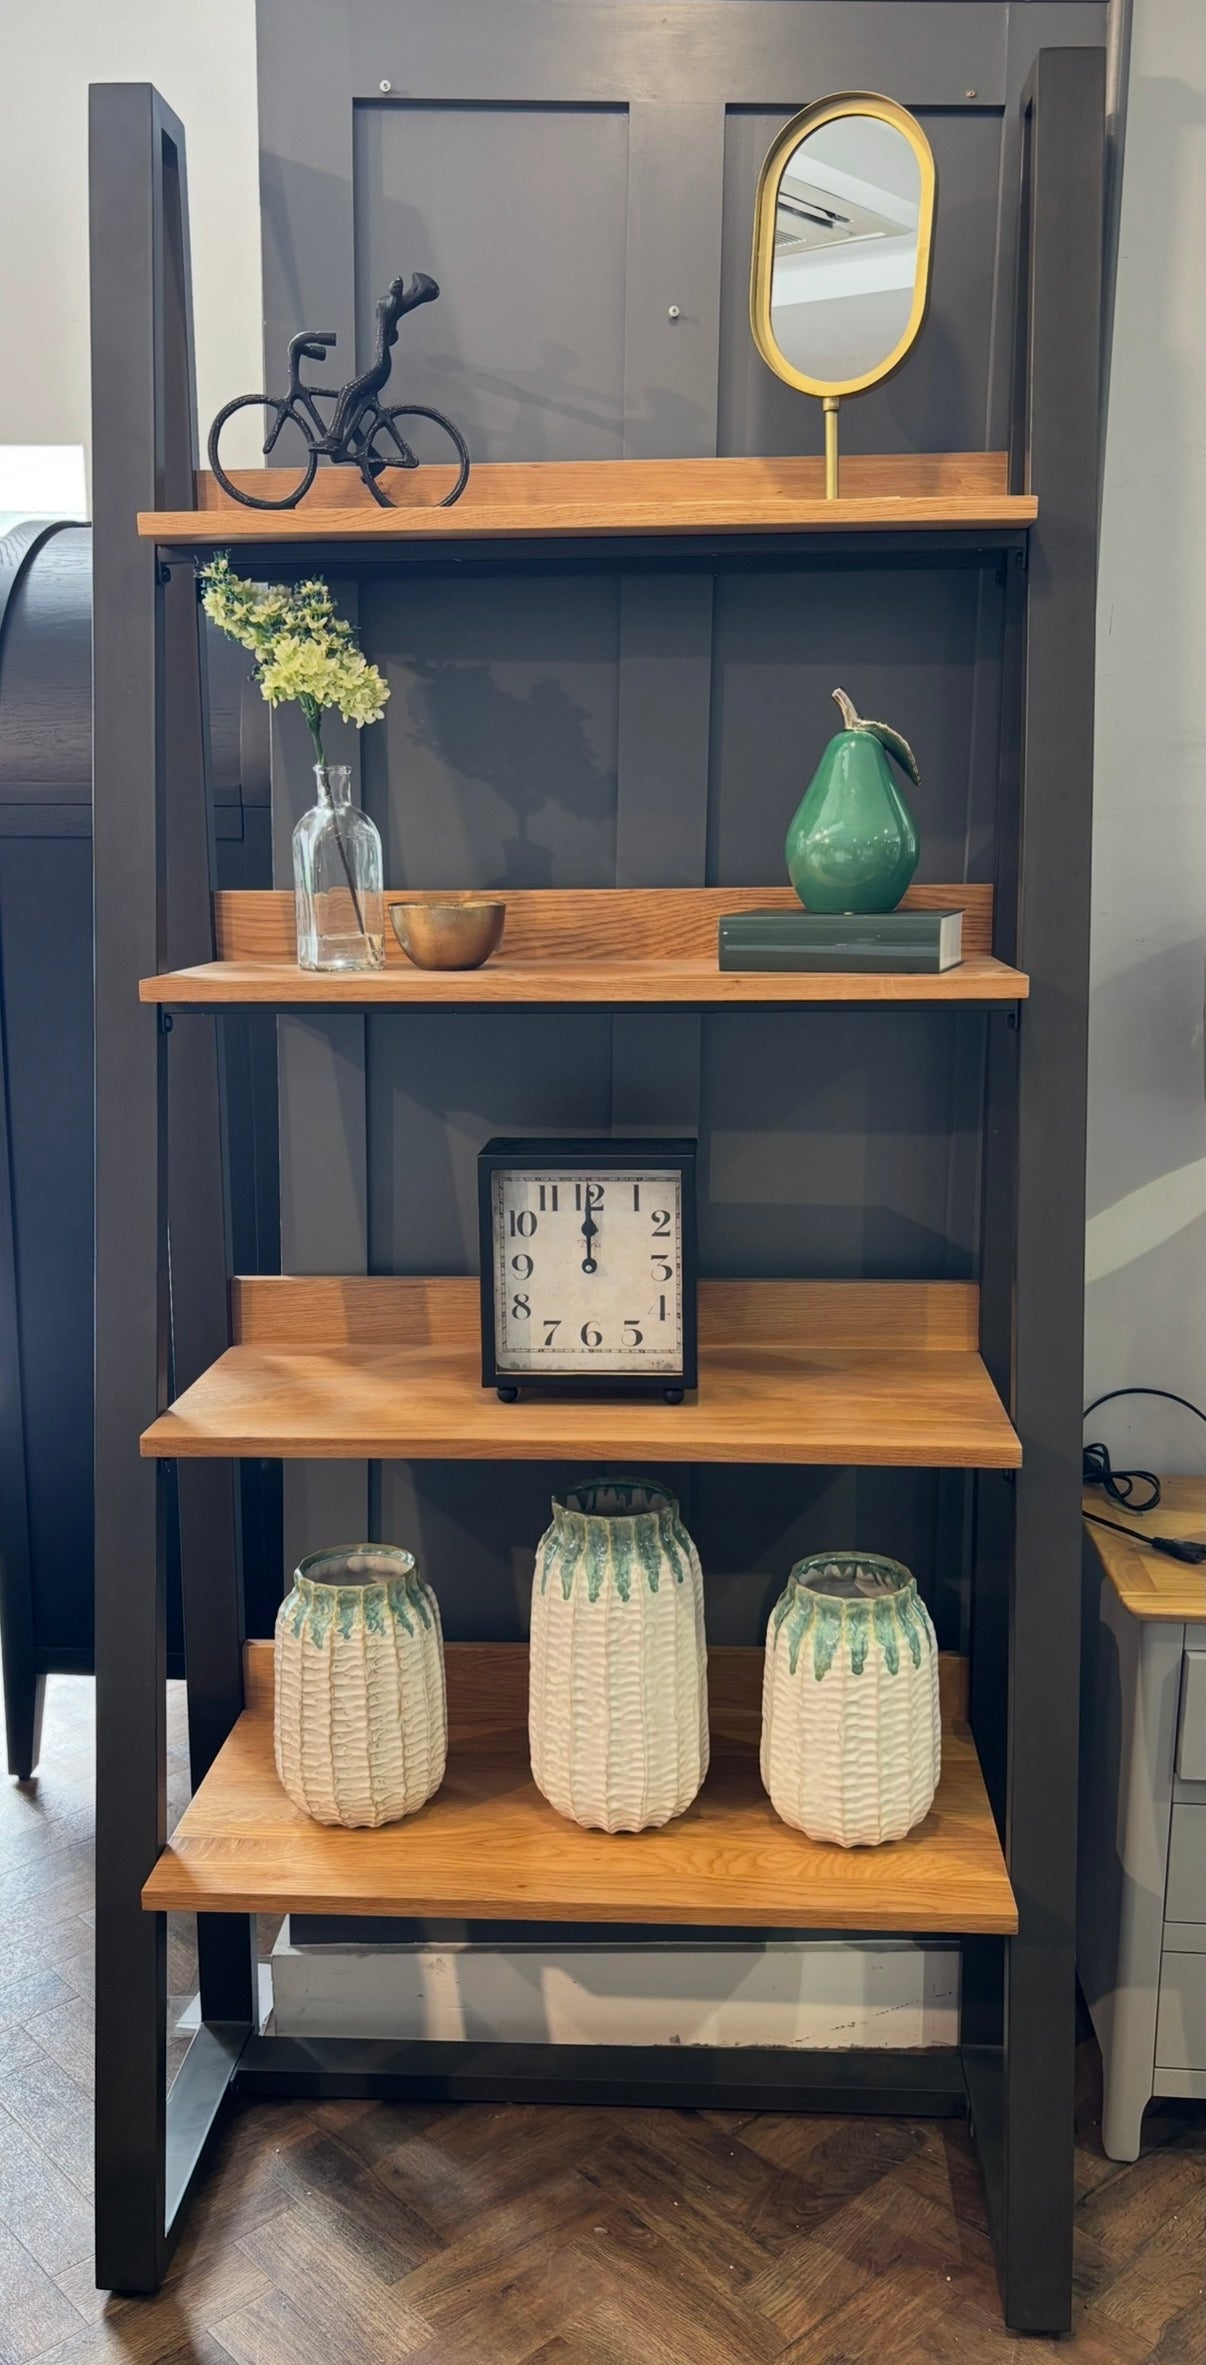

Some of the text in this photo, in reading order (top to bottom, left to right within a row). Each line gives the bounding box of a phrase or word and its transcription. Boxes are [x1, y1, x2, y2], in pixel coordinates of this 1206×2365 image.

[539, 1184, 558, 1212] 11
[575, 1183, 605, 1211] 12
[633, 1184, 640, 1212] 1
[509, 1210, 537, 1237] 10
[651, 1209, 671, 1237] 2
[511, 1254, 534, 1281] 9
[650, 1254, 673, 1282] 3
[511, 1293, 531, 1320] 8
[647, 1294, 671, 1321] 4
[543, 1320, 562, 1346] 7
[580, 1320, 603, 1347] 6
[621, 1320, 643, 1347] 5
